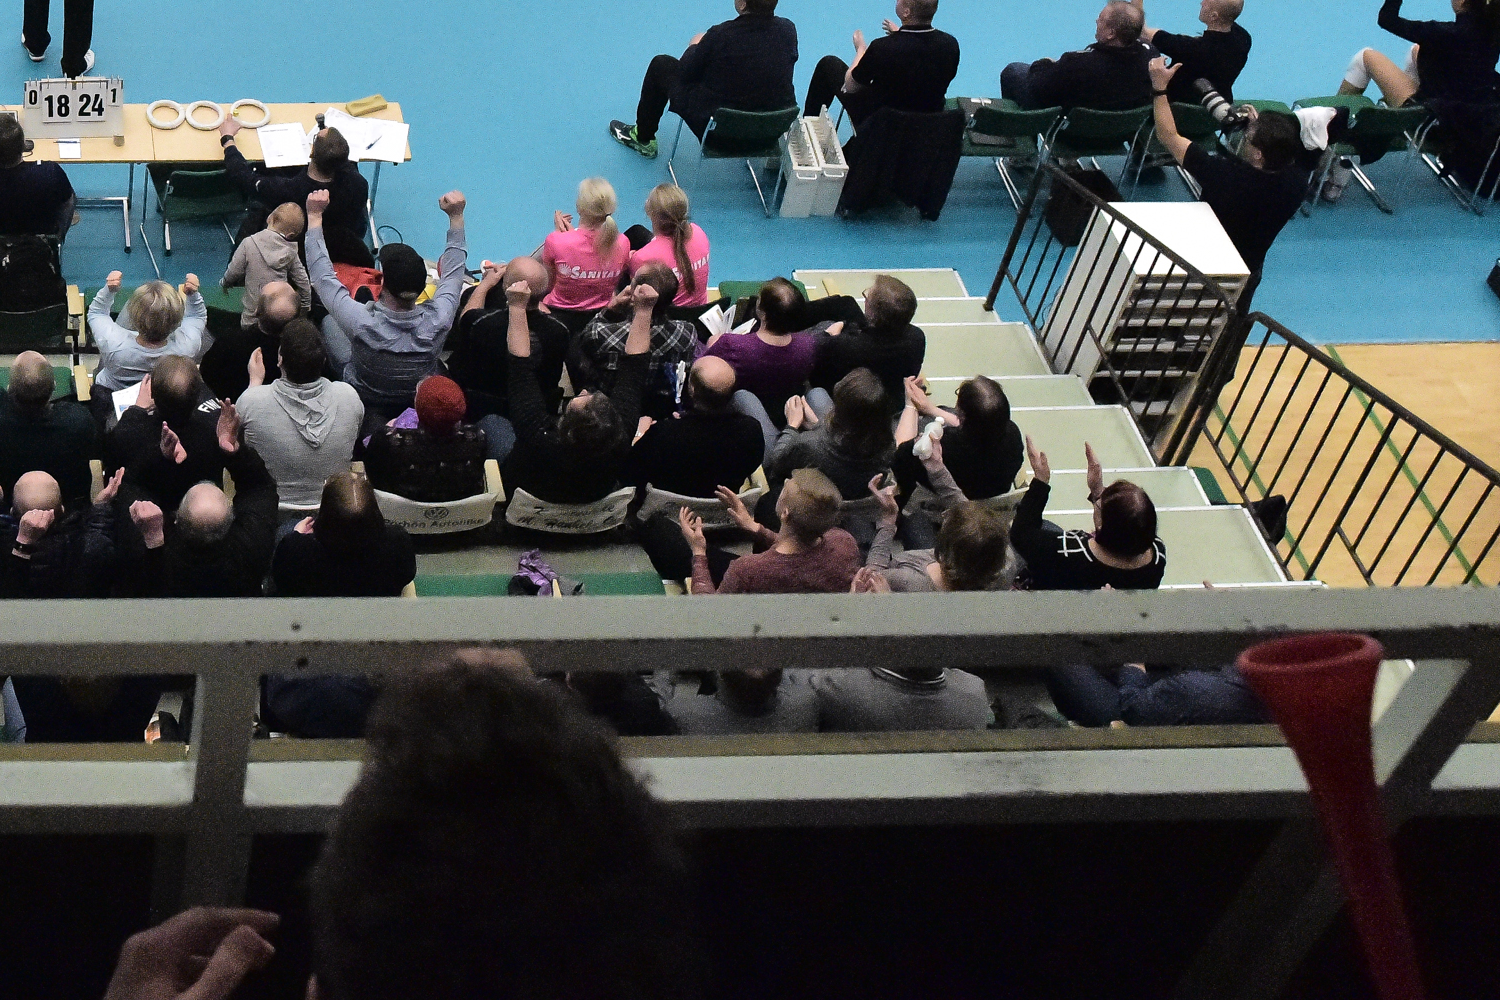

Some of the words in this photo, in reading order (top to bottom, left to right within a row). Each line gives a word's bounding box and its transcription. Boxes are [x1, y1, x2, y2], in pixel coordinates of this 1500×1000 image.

[29, 90, 38, 105] 0
[44, 95, 70, 117] 18
[78, 94, 104, 117] 24
[111, 88, 117, 103] 1
